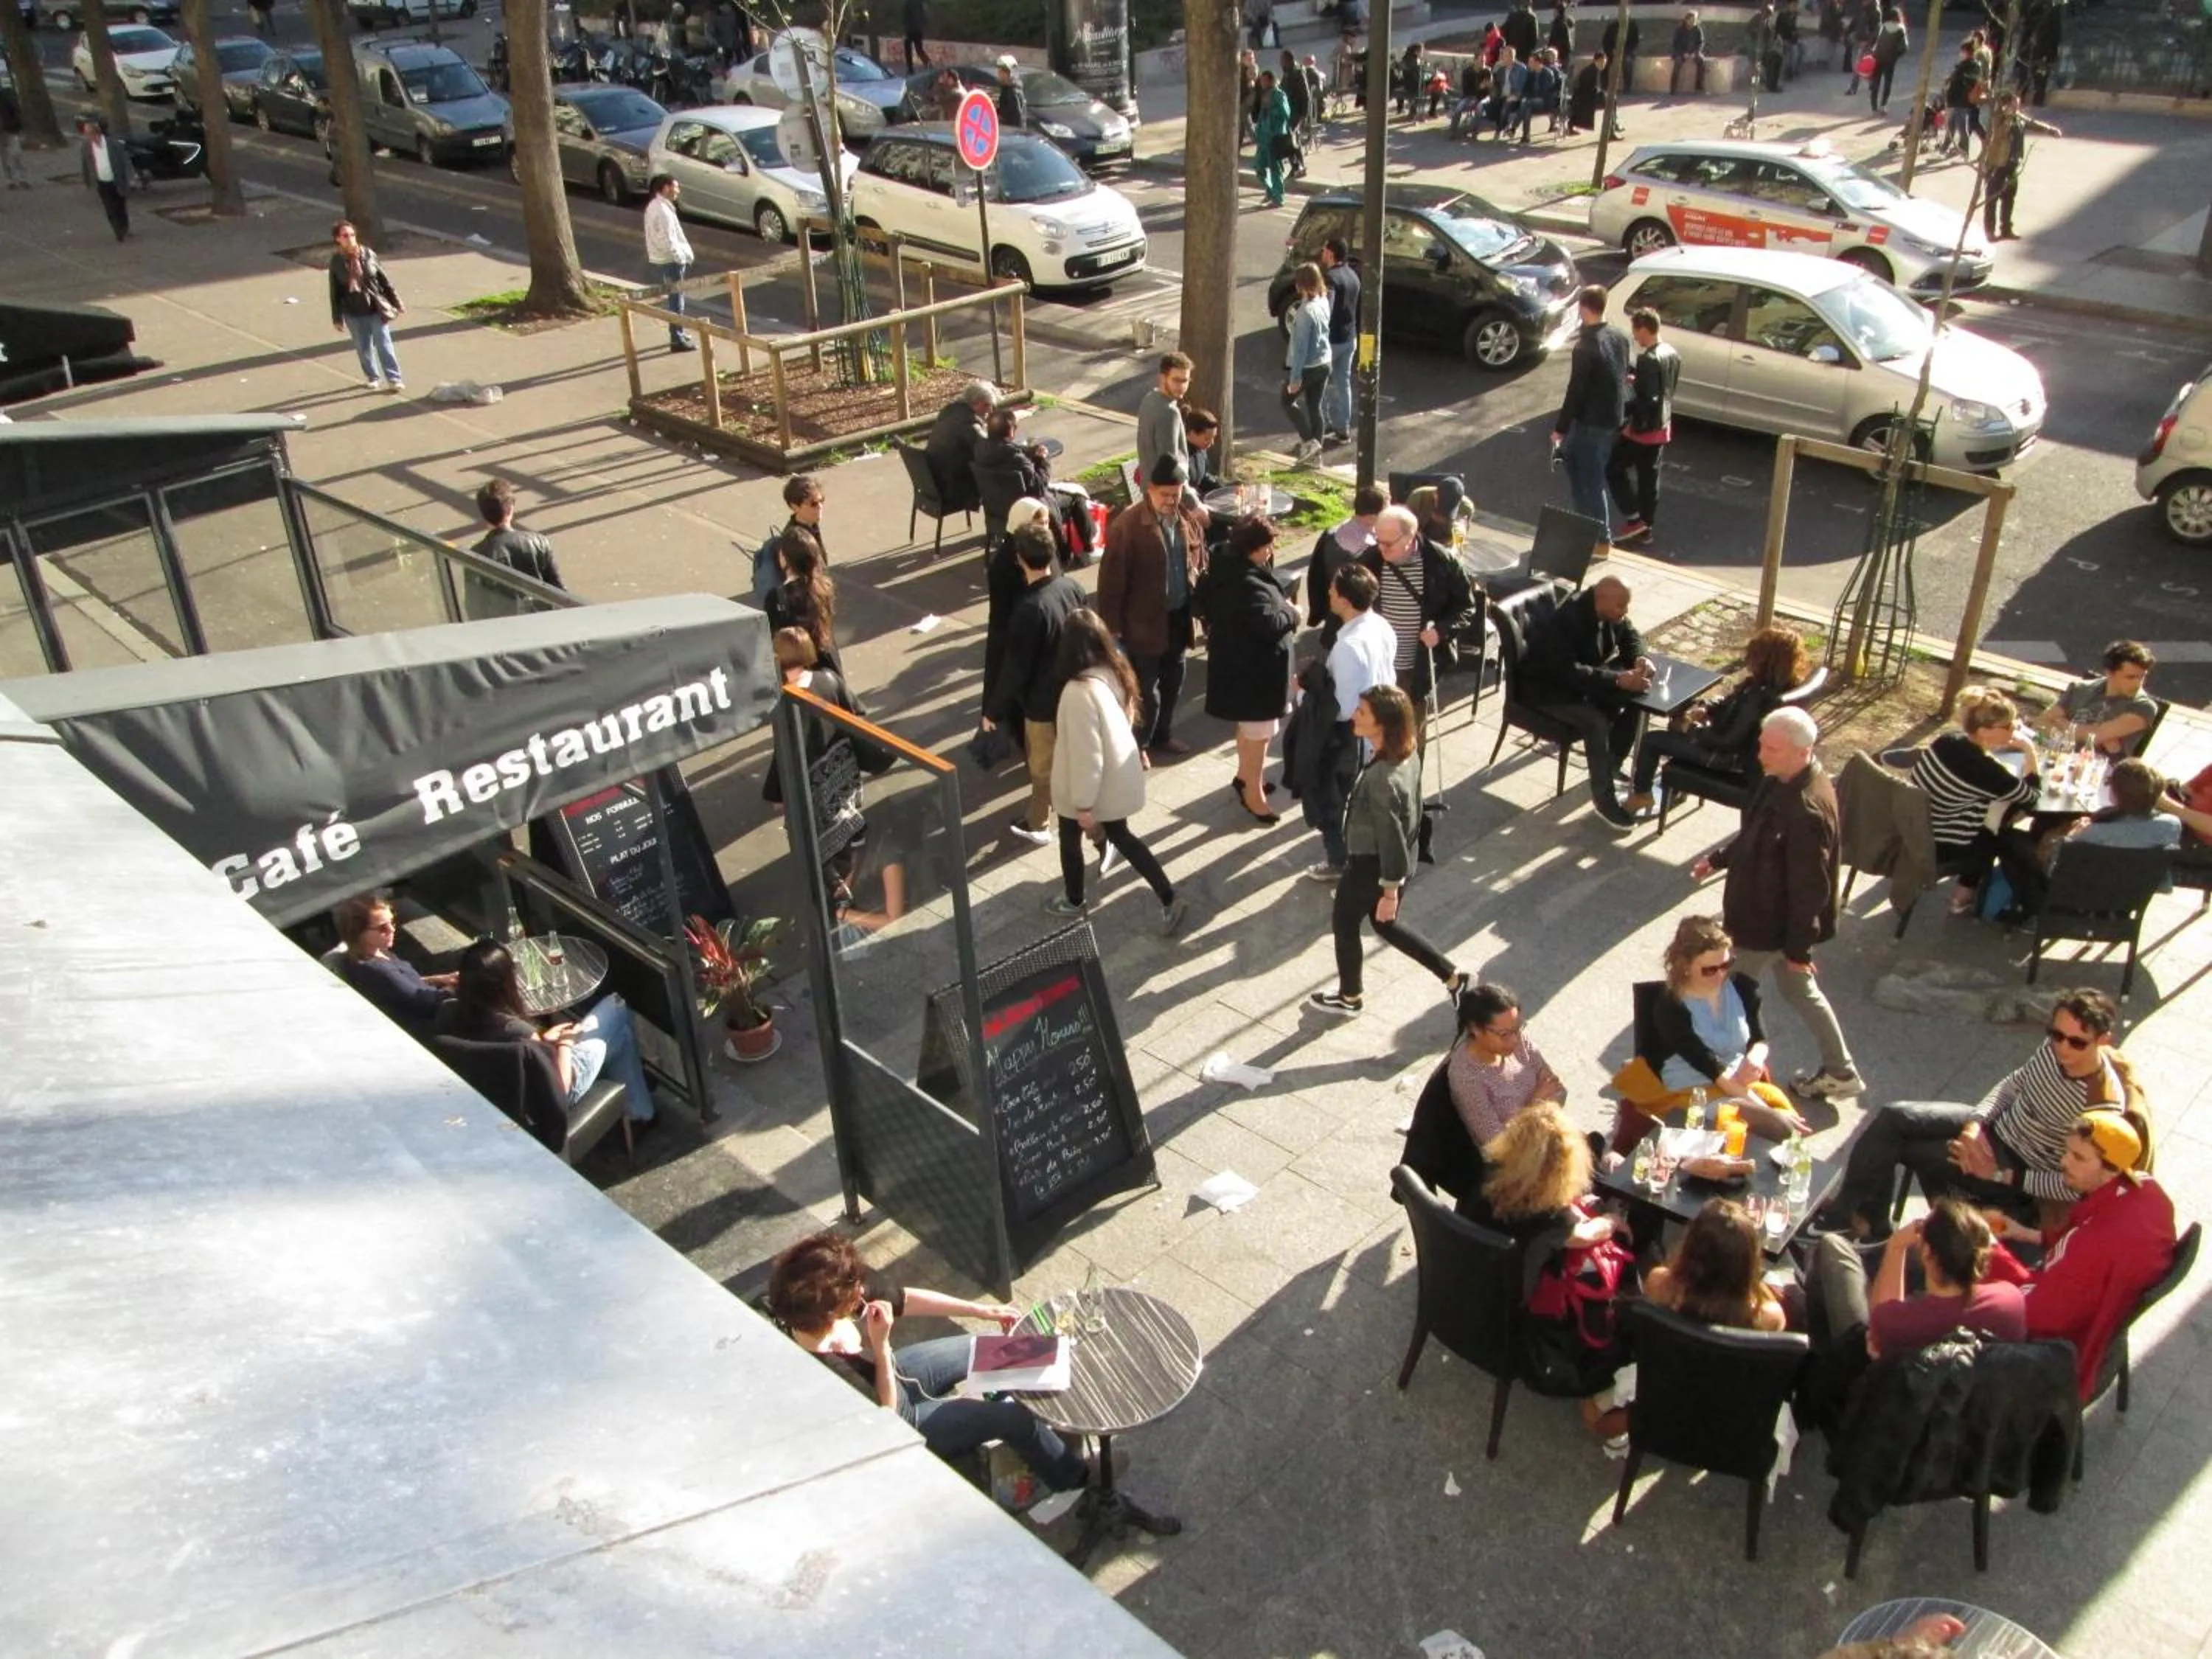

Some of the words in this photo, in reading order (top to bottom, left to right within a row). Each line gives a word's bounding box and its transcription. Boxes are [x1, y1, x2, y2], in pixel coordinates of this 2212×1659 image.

[211, 811, 361, 901] Café
[413, 666, 731, 825] Restaurant
[585, 812, 602, 824] NOS
